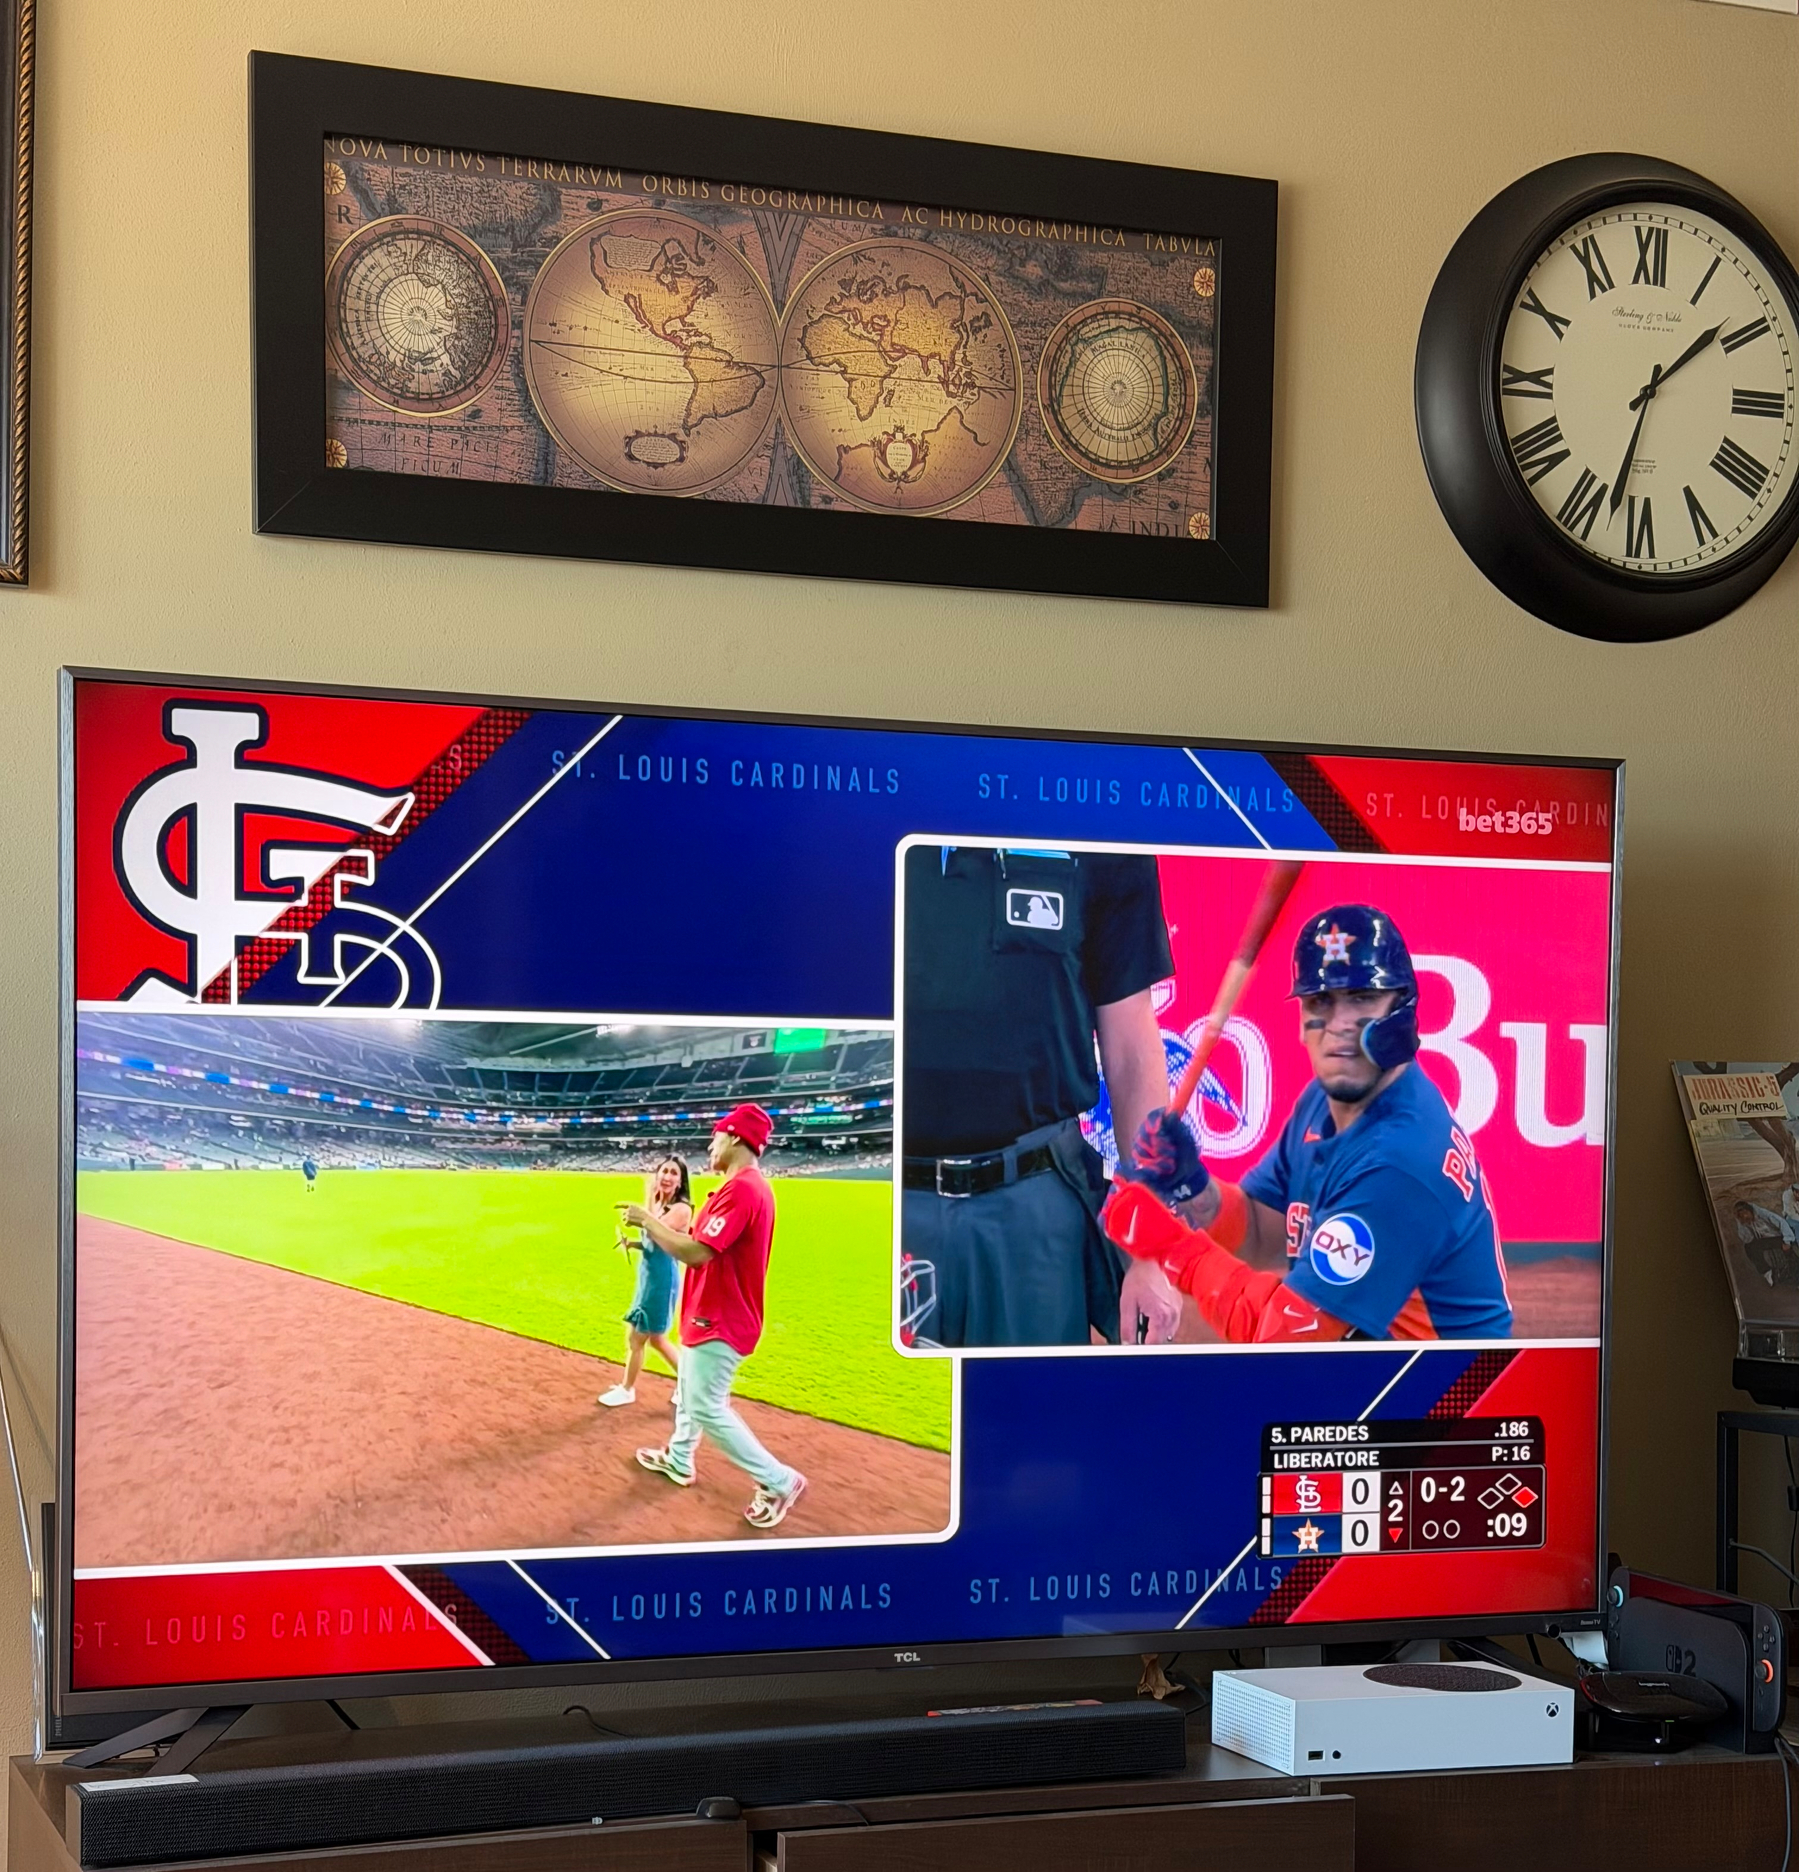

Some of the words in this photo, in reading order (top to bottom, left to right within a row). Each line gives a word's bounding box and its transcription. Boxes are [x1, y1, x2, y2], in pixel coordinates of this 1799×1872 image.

[336, 204, 354, 225] R
[398, 143, 486, 172] TOTIVS
[497, 156, 623, 189] TERRARVM
[642, 174, 710, 199] ORBIS
[720, 184, 885, 221] GEOGRAPHICA
[900, 205, 930, 226] AC
[939, 211, 1127, 248] HYDROGRAPHICA
[1144, 231, 1217, 258] TABVLA
[618, 753, 710, 785] LOUIS
[731, 759, 901, 795] CARDINALS
[977, 773, 1019, 800] ST.
[1038, 776, 1122, 806] LOUIS
[1140, 781, 1296, 813] CARDINALS
[1366, 791, 1402, 819] ST.
[1458, 807, 1553, 835] bet365
[1699, 1101, 1738, 1116] QUALITY
[1740, 1100, 1785, 1114] CONTROL
[701, 1215, 726, 1238] 19
[1314, 1230, 1371, 1267] OXY
[1271, 1427, 1287, 1443] 5.
[1290, 1425, 1370, 1442] PAREDES
[1493, 1421, 1530, 1438] .186
[1273, 1450, 1380, 1469] LIBERATORE
[1491, 1446, 1508, 1462] P:
[1511, 1445, 1531, 1461] 16
[1351, 1477, 1370, 1506] 0
[1420, 1476, 1466, 1502] 0-2
[1387, 1499, 1404, 1522] 2
[1351, 1519, 1370, 1547] 0
[1486, 1512, 1528, 1538] :09
[969, 1577, 1010, 1604] ST.
[1029, 1573, 1112, 1602] LOUIS
[1129, 1565, 1283, 1597] CARDINALS
[612, 1591, 702, 1622] LOUIS
[723, 1582, 892, 1617] CARDINALS
[145, 1613, 247, 1647] LOUIS
[271, 1602, 459, 1640] CARDINALS
[893, 1651, 921, 1663] TCL
[1683, 1650, 1697, 1678] 2
